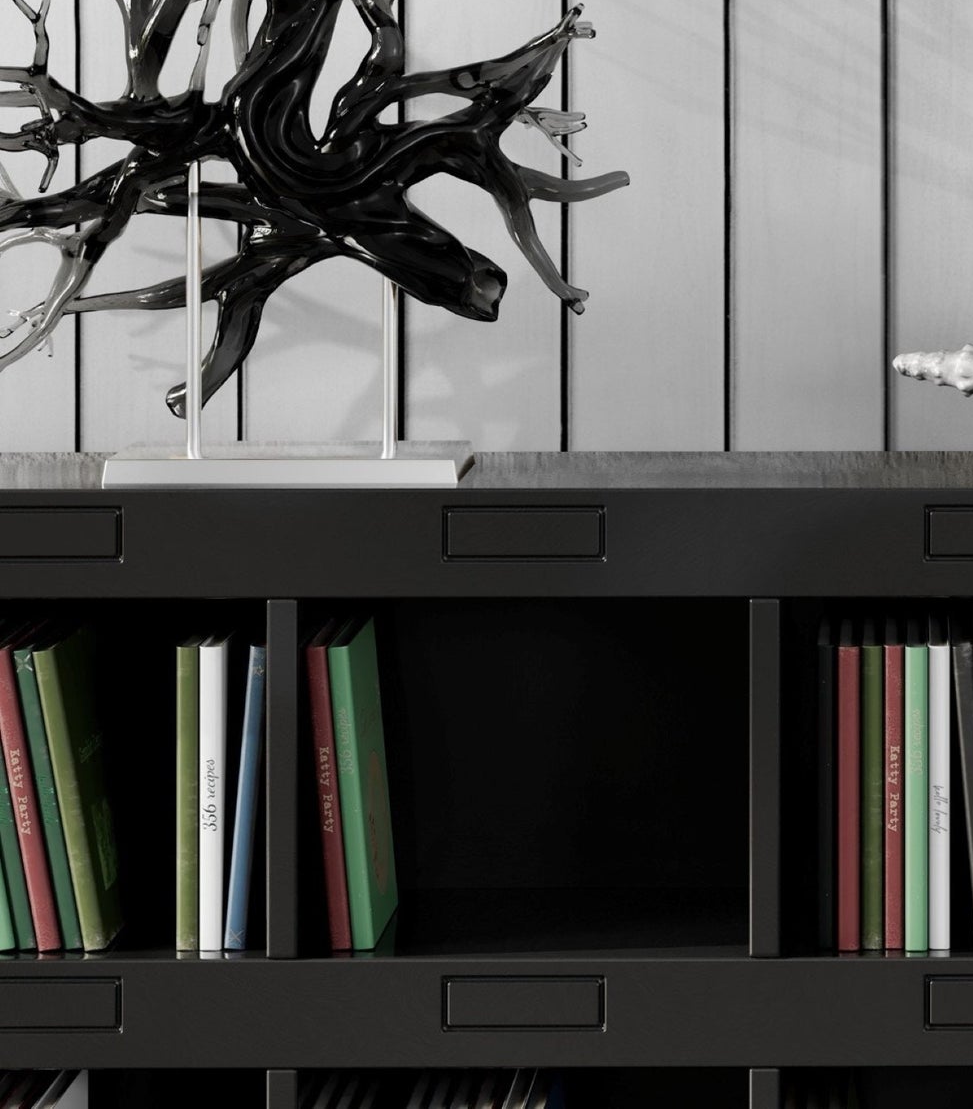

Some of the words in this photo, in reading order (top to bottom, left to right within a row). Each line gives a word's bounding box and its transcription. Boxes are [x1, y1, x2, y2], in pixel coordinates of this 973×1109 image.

[204, 759, 220, 799] recipes
[319, 746, 331, 786] Katty
[888, 745, 901, 785] Katty
[9, 748, 24, 789] Katty
[17, 795, 32, 835] Party
[202, 804, 218, 832] 356
[323, 794, 335, 833] Party
[887, 792, 901, 832] Party
